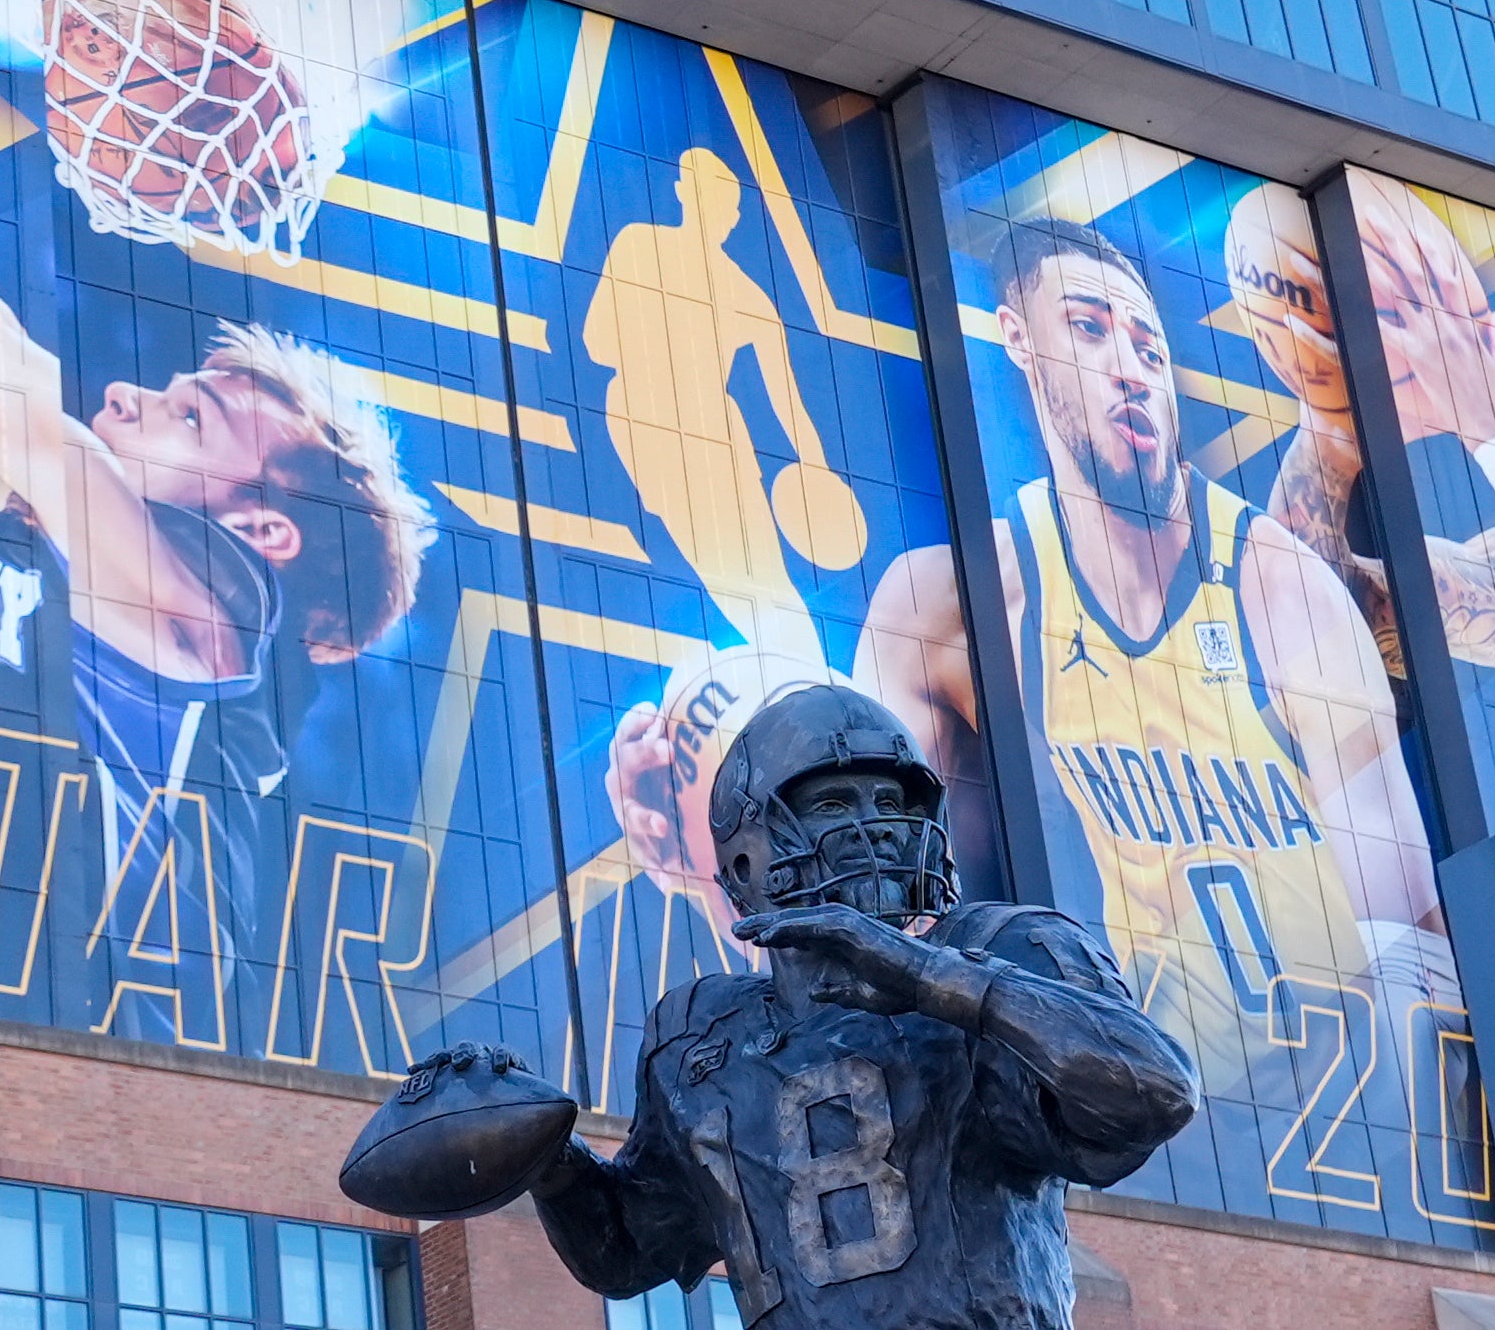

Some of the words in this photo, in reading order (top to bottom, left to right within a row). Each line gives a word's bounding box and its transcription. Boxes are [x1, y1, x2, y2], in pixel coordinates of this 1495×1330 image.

[1050, 741, 1325, 853] INDIANA
[1184, 860, 1295, 1015] 0
[398, 1071, 430, 1098] NFL
[691, 1054, 917, 1330] 18
